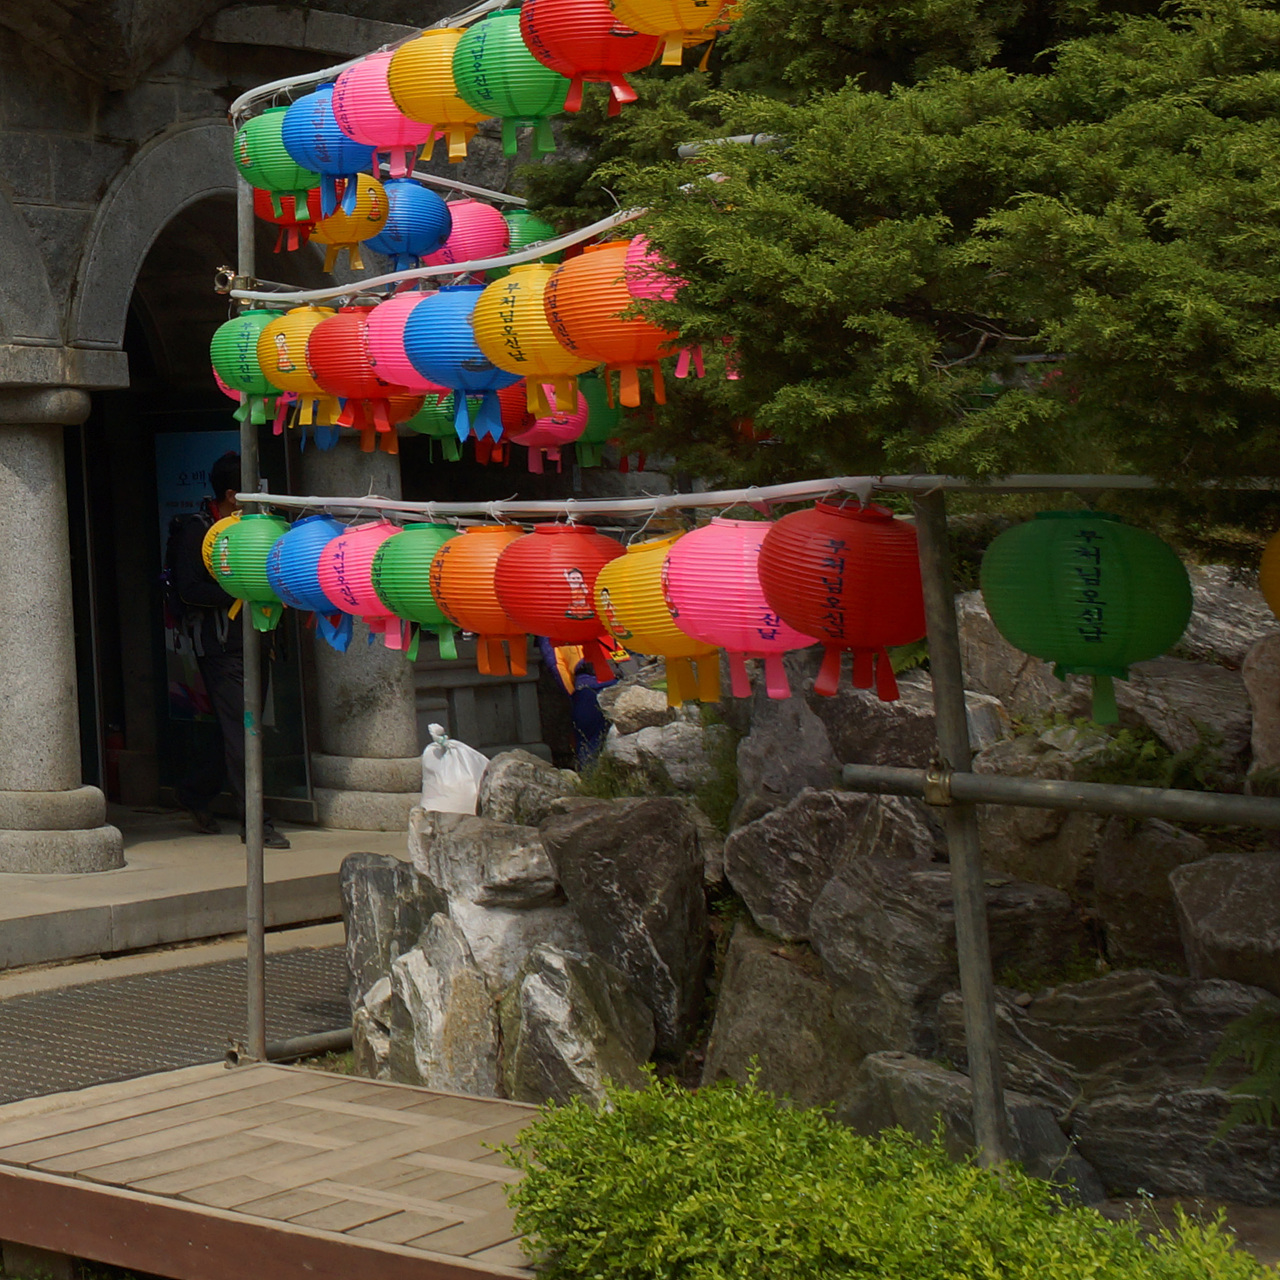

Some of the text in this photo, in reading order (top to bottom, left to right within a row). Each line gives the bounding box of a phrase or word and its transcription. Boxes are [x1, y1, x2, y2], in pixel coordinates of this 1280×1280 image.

[470, 22, 494, 100] 부처님오신날
[500, 282, 528, 362] 부처님오신날
[332, 541, 359, 606] 부처님오신날
